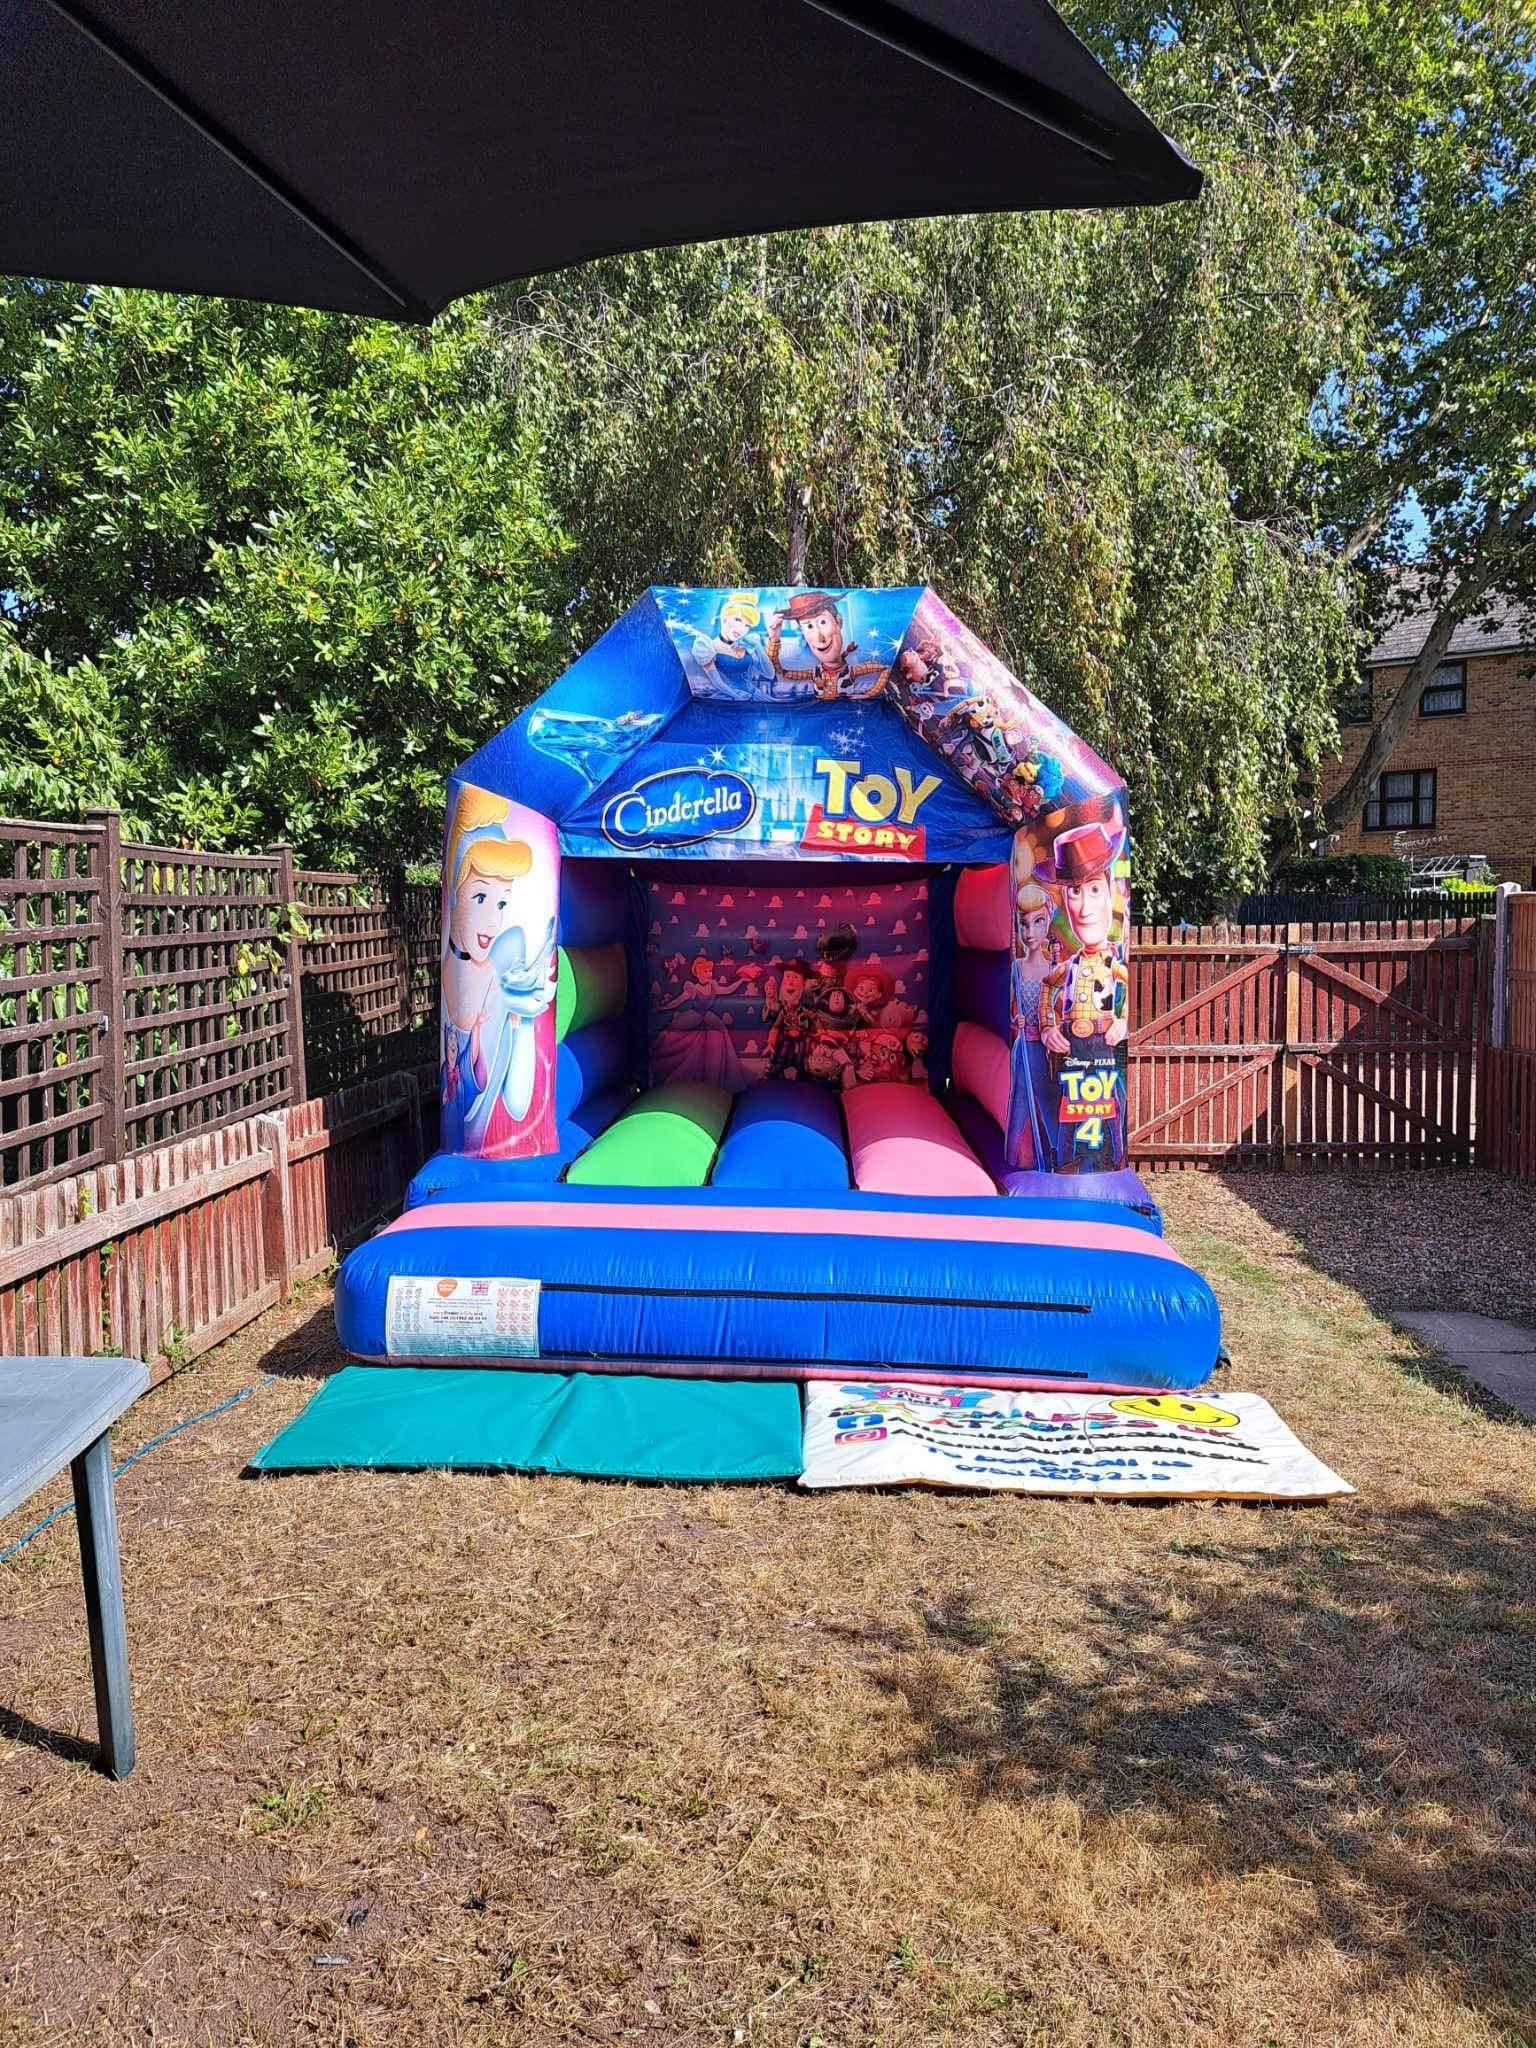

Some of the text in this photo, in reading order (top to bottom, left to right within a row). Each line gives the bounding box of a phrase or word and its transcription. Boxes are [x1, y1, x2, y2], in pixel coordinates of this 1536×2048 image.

[815, 758, 944, 825] TOY
[615, 786, 742, 837] Cinderella
[816, 822, 918, 850] STORY
[1060, 1071, 1119, 1102] TOY
[1066, 1103, 1113, 1115] STORY
[1075, 1116, 1104, 1148] 4
